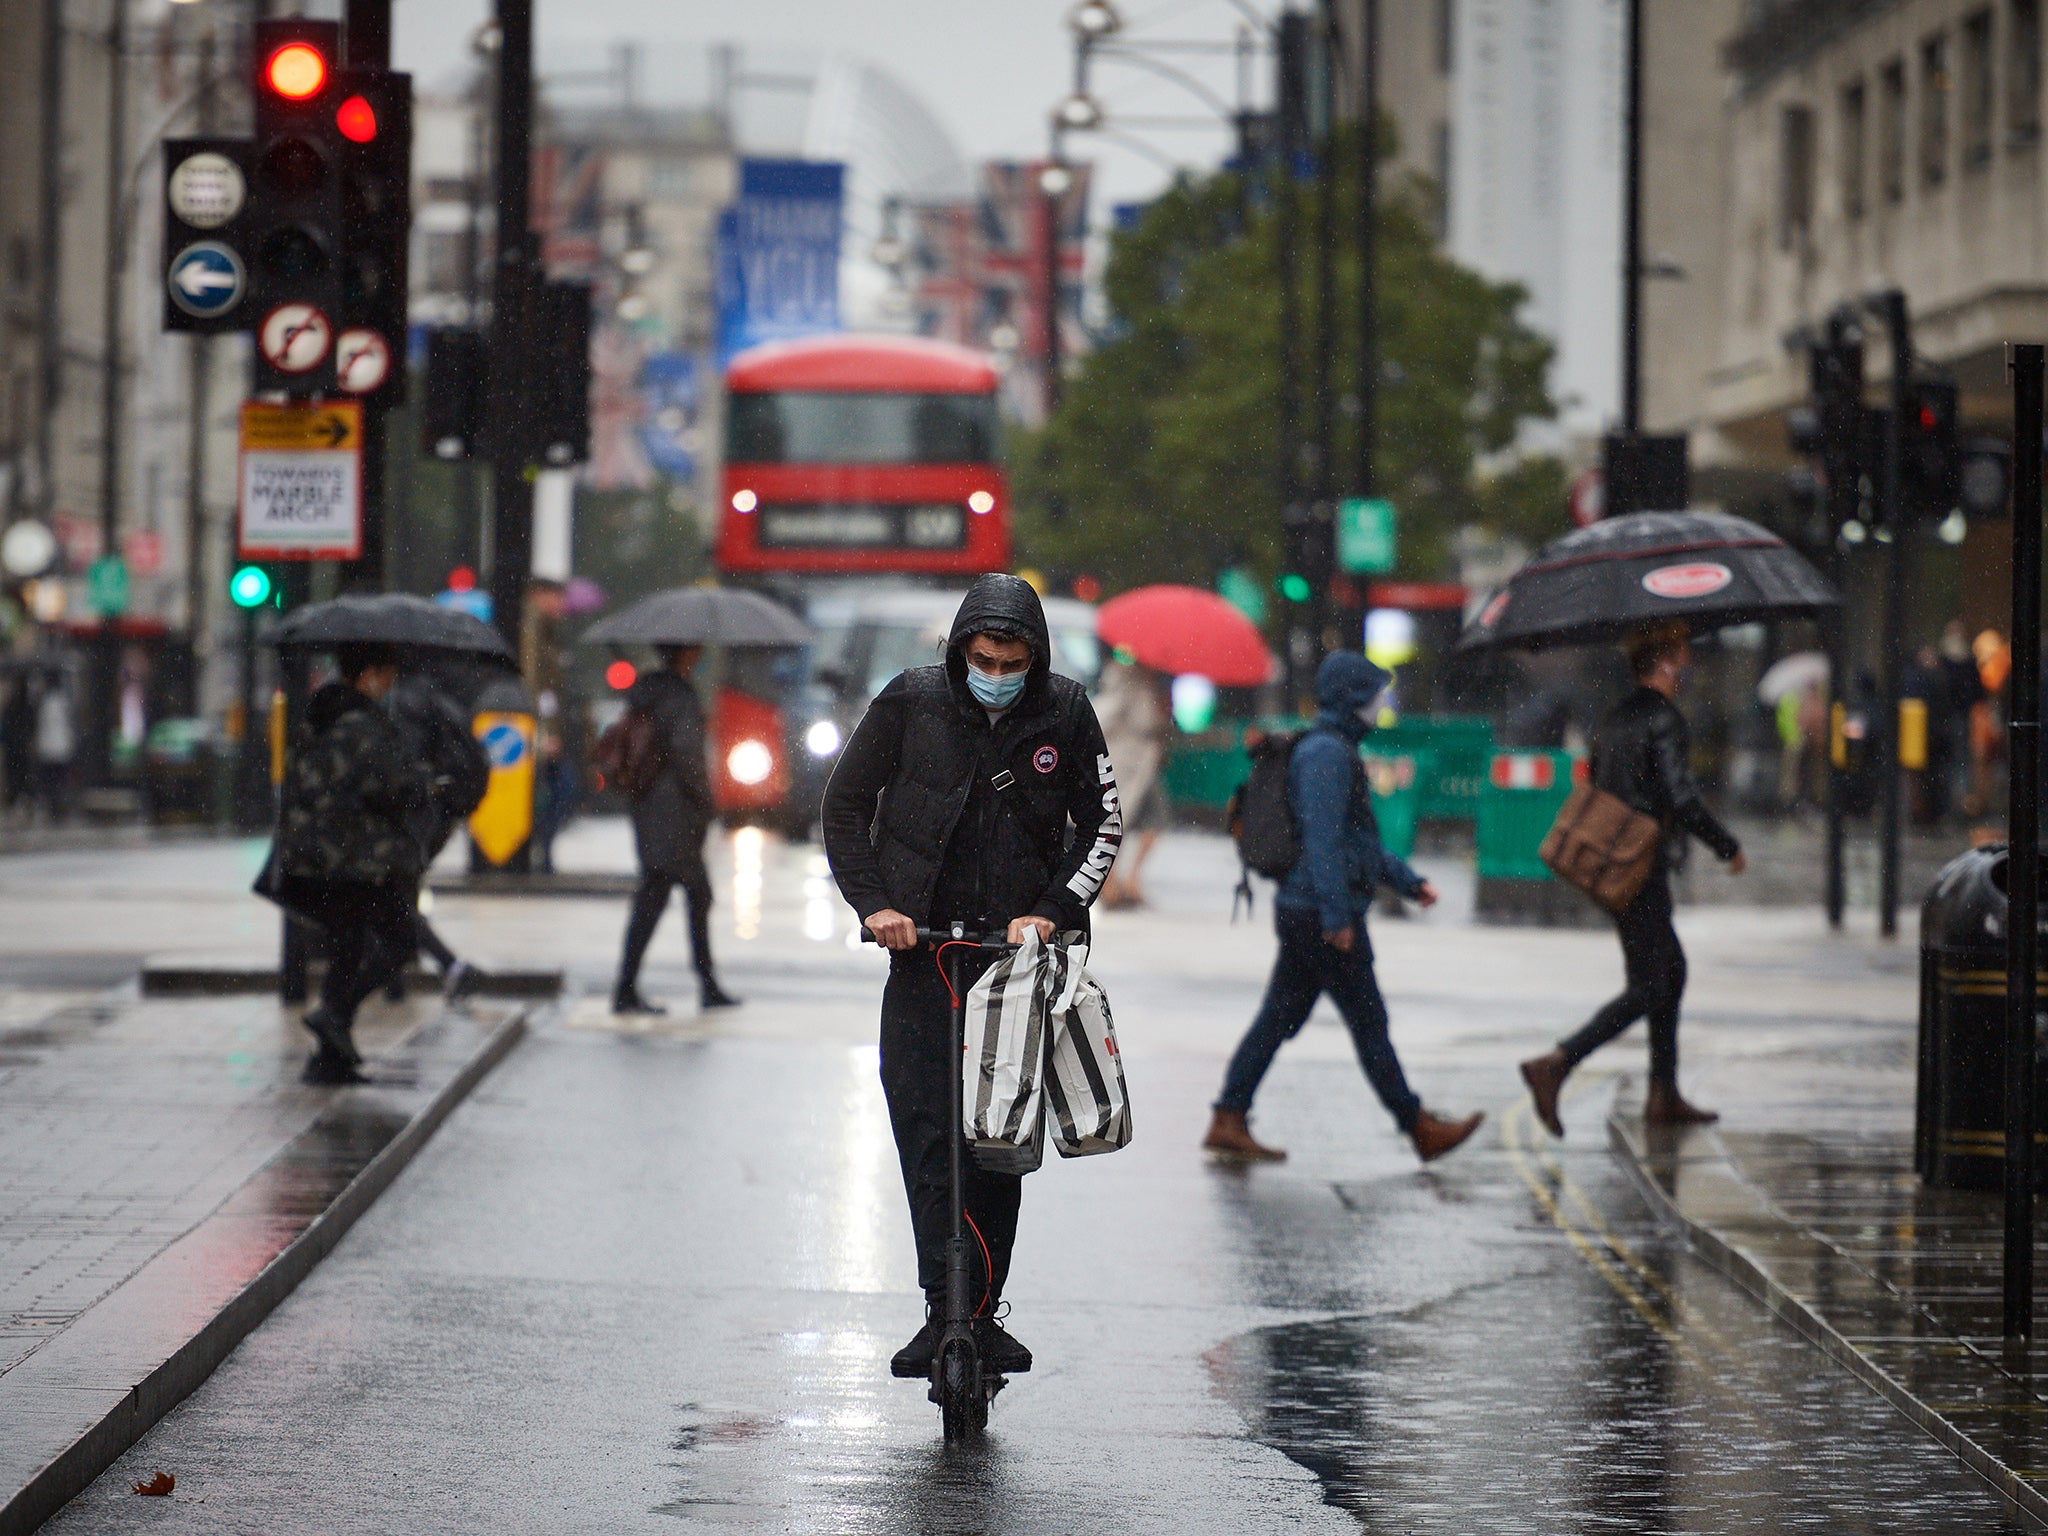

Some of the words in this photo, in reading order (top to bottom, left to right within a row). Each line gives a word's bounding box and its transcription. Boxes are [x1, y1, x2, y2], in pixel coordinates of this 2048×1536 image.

[254, 464, 345, 480] TOWARDS
[252, 485, 345, 503] MARBLE
[266, 505, 331, 522] ARCH
[1066, 837, 1120, 906] JUST
[1099, 787, 1123, 836] DO
